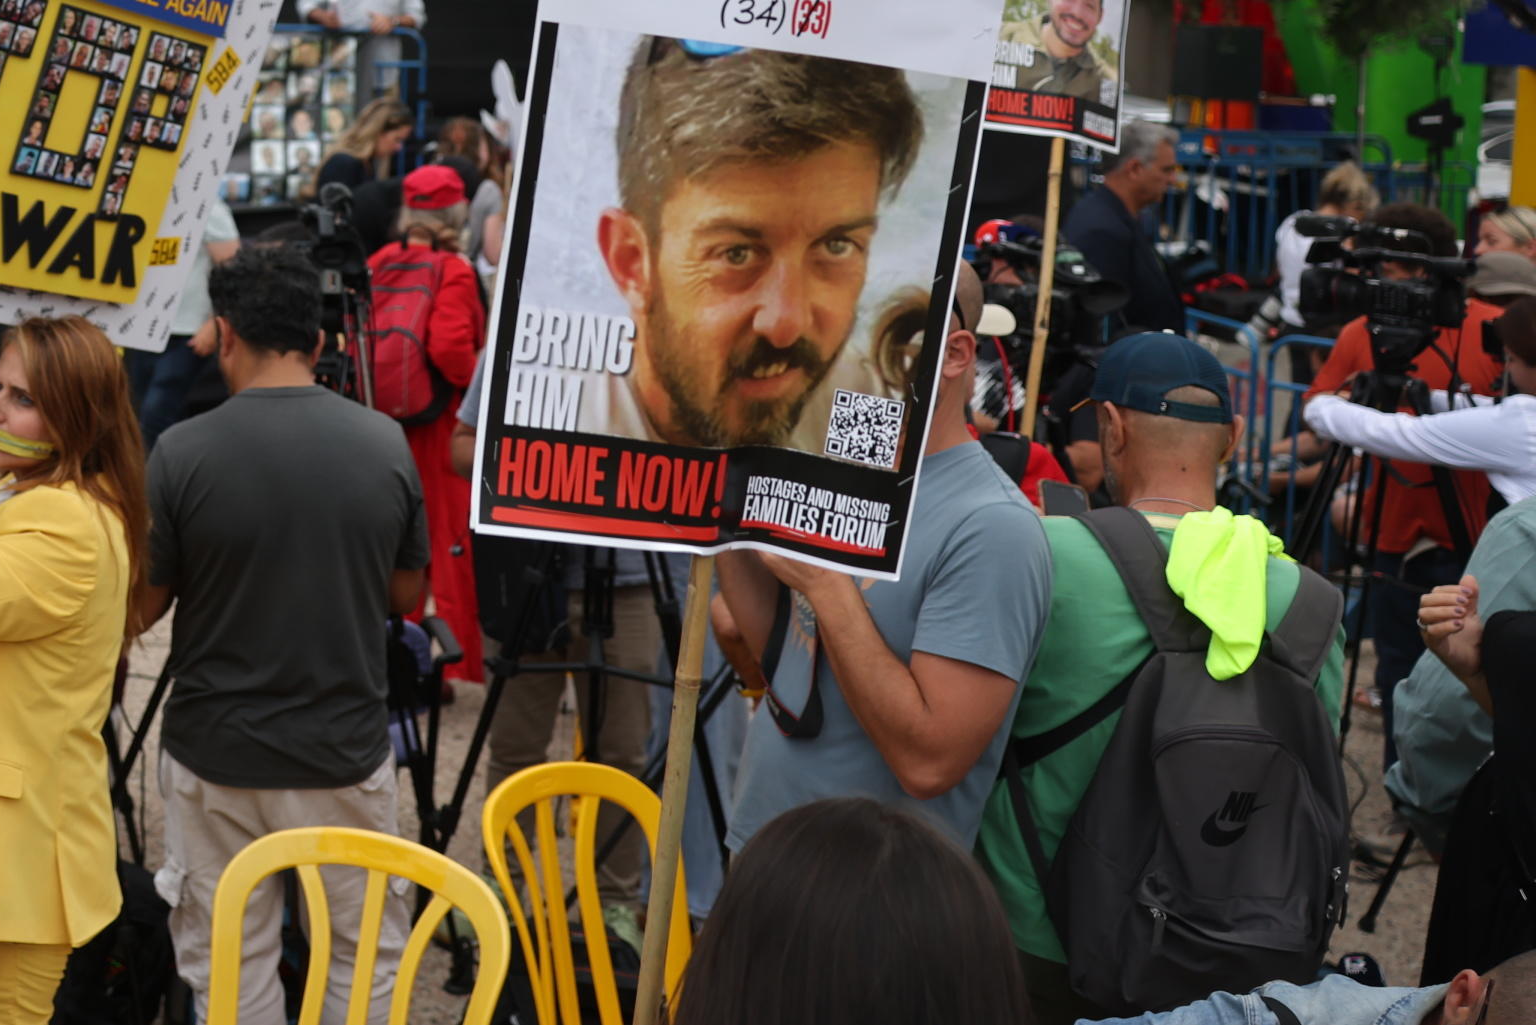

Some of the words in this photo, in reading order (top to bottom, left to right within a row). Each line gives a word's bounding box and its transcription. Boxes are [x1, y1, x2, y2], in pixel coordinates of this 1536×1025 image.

[206, 52, 240, 94] 584
[989, 89, 1029, 115] HOME
[1032, 94, 1075, 122] NOW!
[0, 191, 147, 288] WAR
[149, 239, 179, 266] 584
[513, 303, 637, 376] BRING
[503, 368, 584, 433] HIM
[497, 437, 609, 507] HOME
[616, 451, 728, 519] NOW!
[747, 475, 807, 504] HOSTAGES
[807, 486, 834, 510] AND
[834, 493, 890, 523] MISSING
[742, 495, 820, 535] FAMILIES
[820, 510, 888, 550] FORUM
